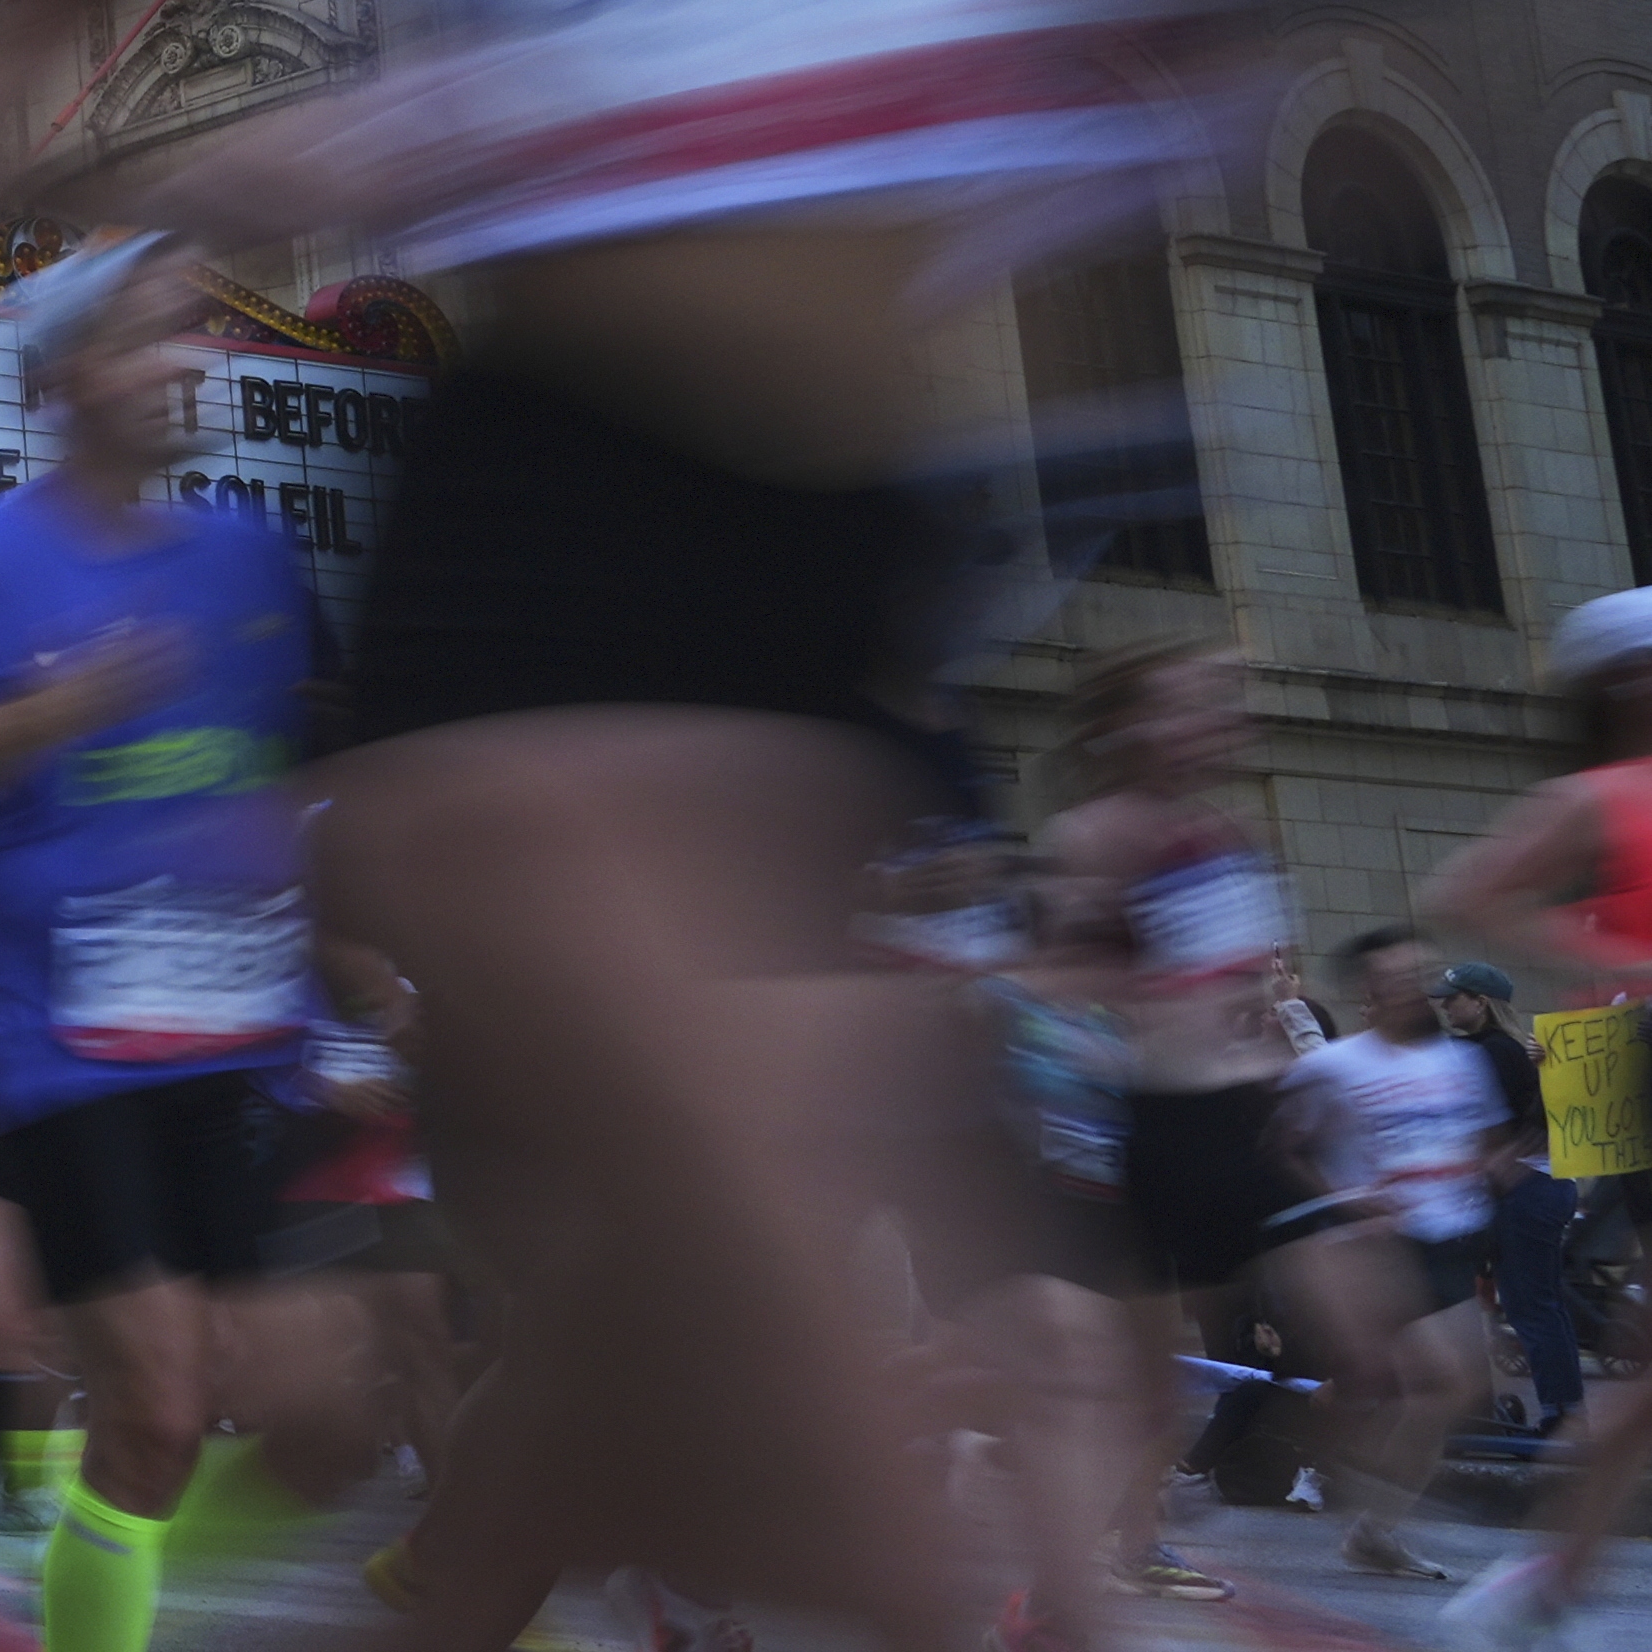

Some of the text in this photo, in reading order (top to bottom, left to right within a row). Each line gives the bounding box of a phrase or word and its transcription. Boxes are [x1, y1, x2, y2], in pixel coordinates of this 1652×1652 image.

[240, 374, 420, 458] BEFOR
[1544, 1016, 1618, 1068] KEEP
[1583, 1051, 1619, 1097] UP
[1547, 1104, 1595, 1159] YOU
